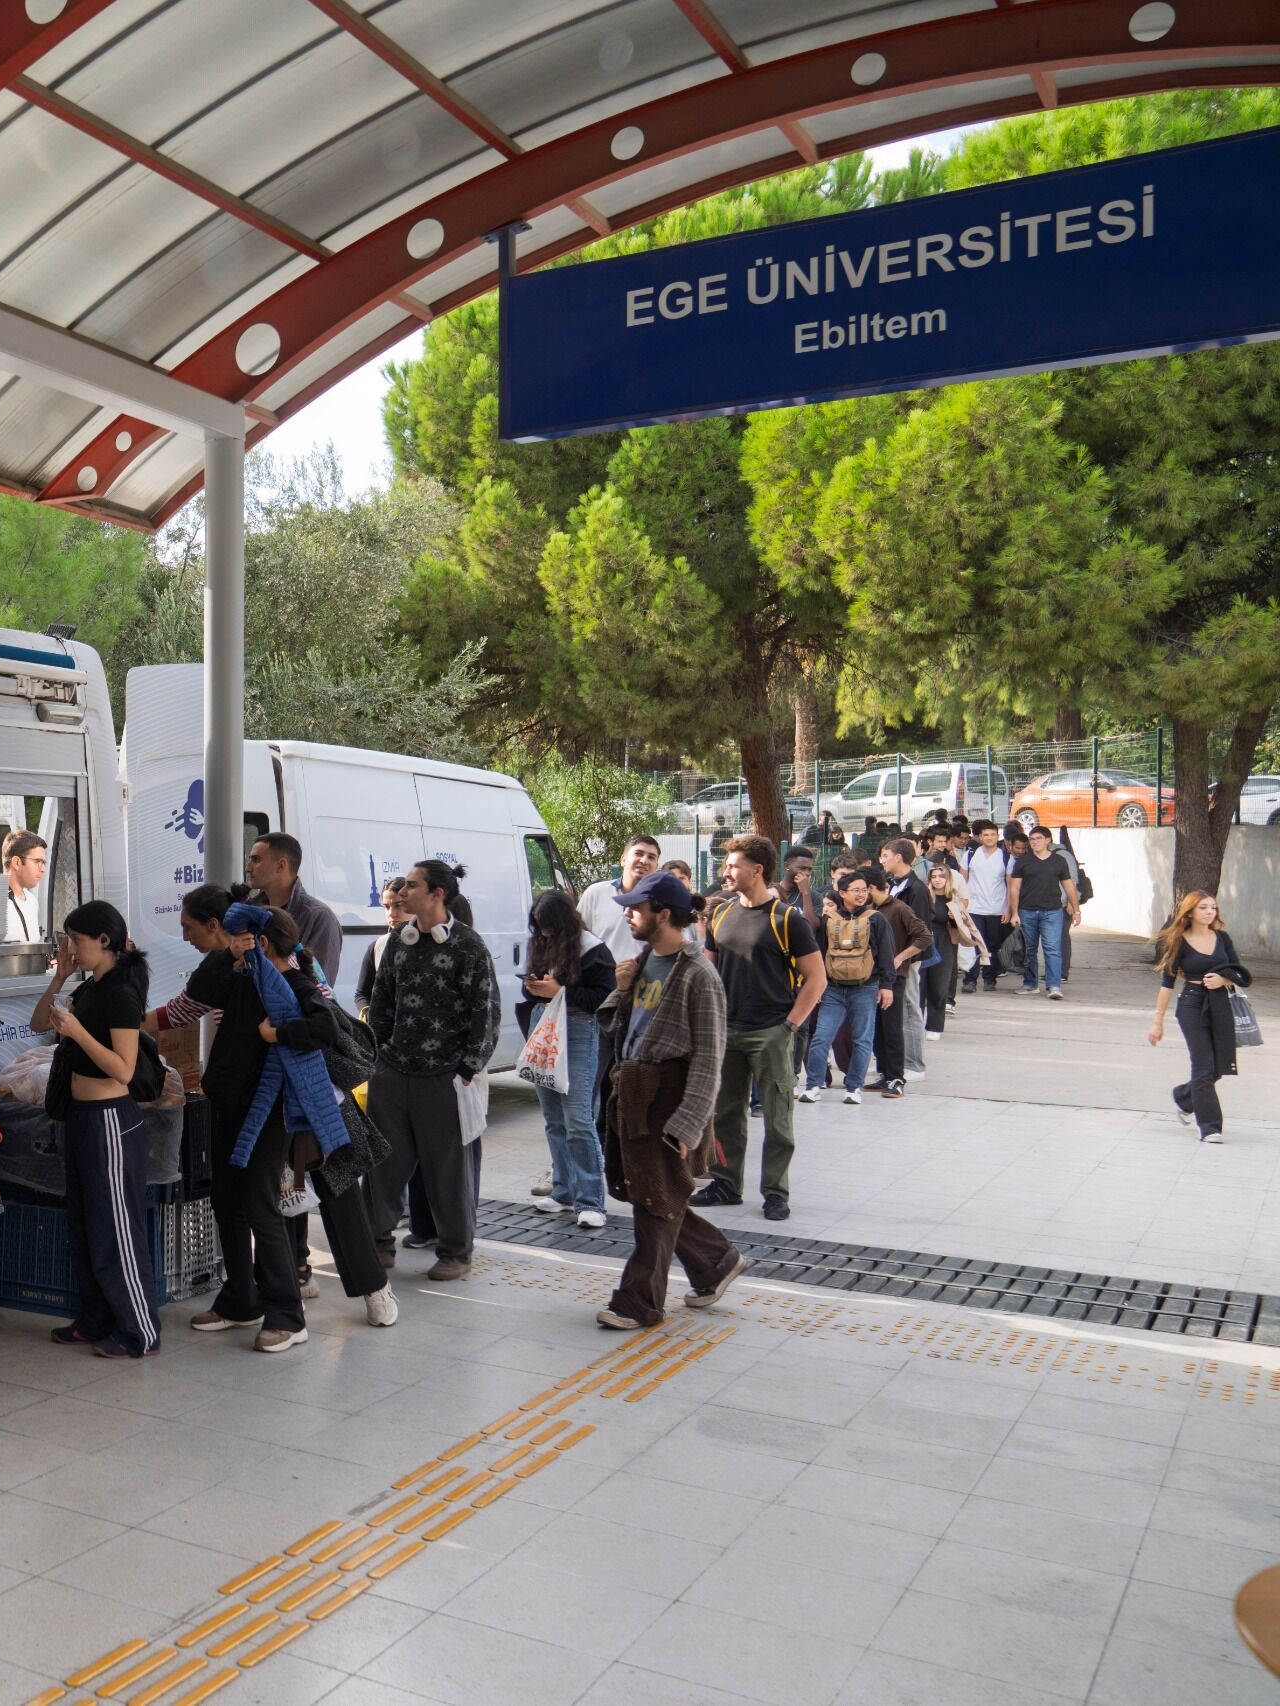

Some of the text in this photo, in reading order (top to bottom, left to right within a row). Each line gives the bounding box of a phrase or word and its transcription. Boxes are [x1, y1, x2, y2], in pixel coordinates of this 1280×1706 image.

[626, 184, 1155, 328] EGE ÜNİVERSİTESİ
[794, 308, 948, 354] Ebiltem
[174, 864, 205, 884] #Biz
